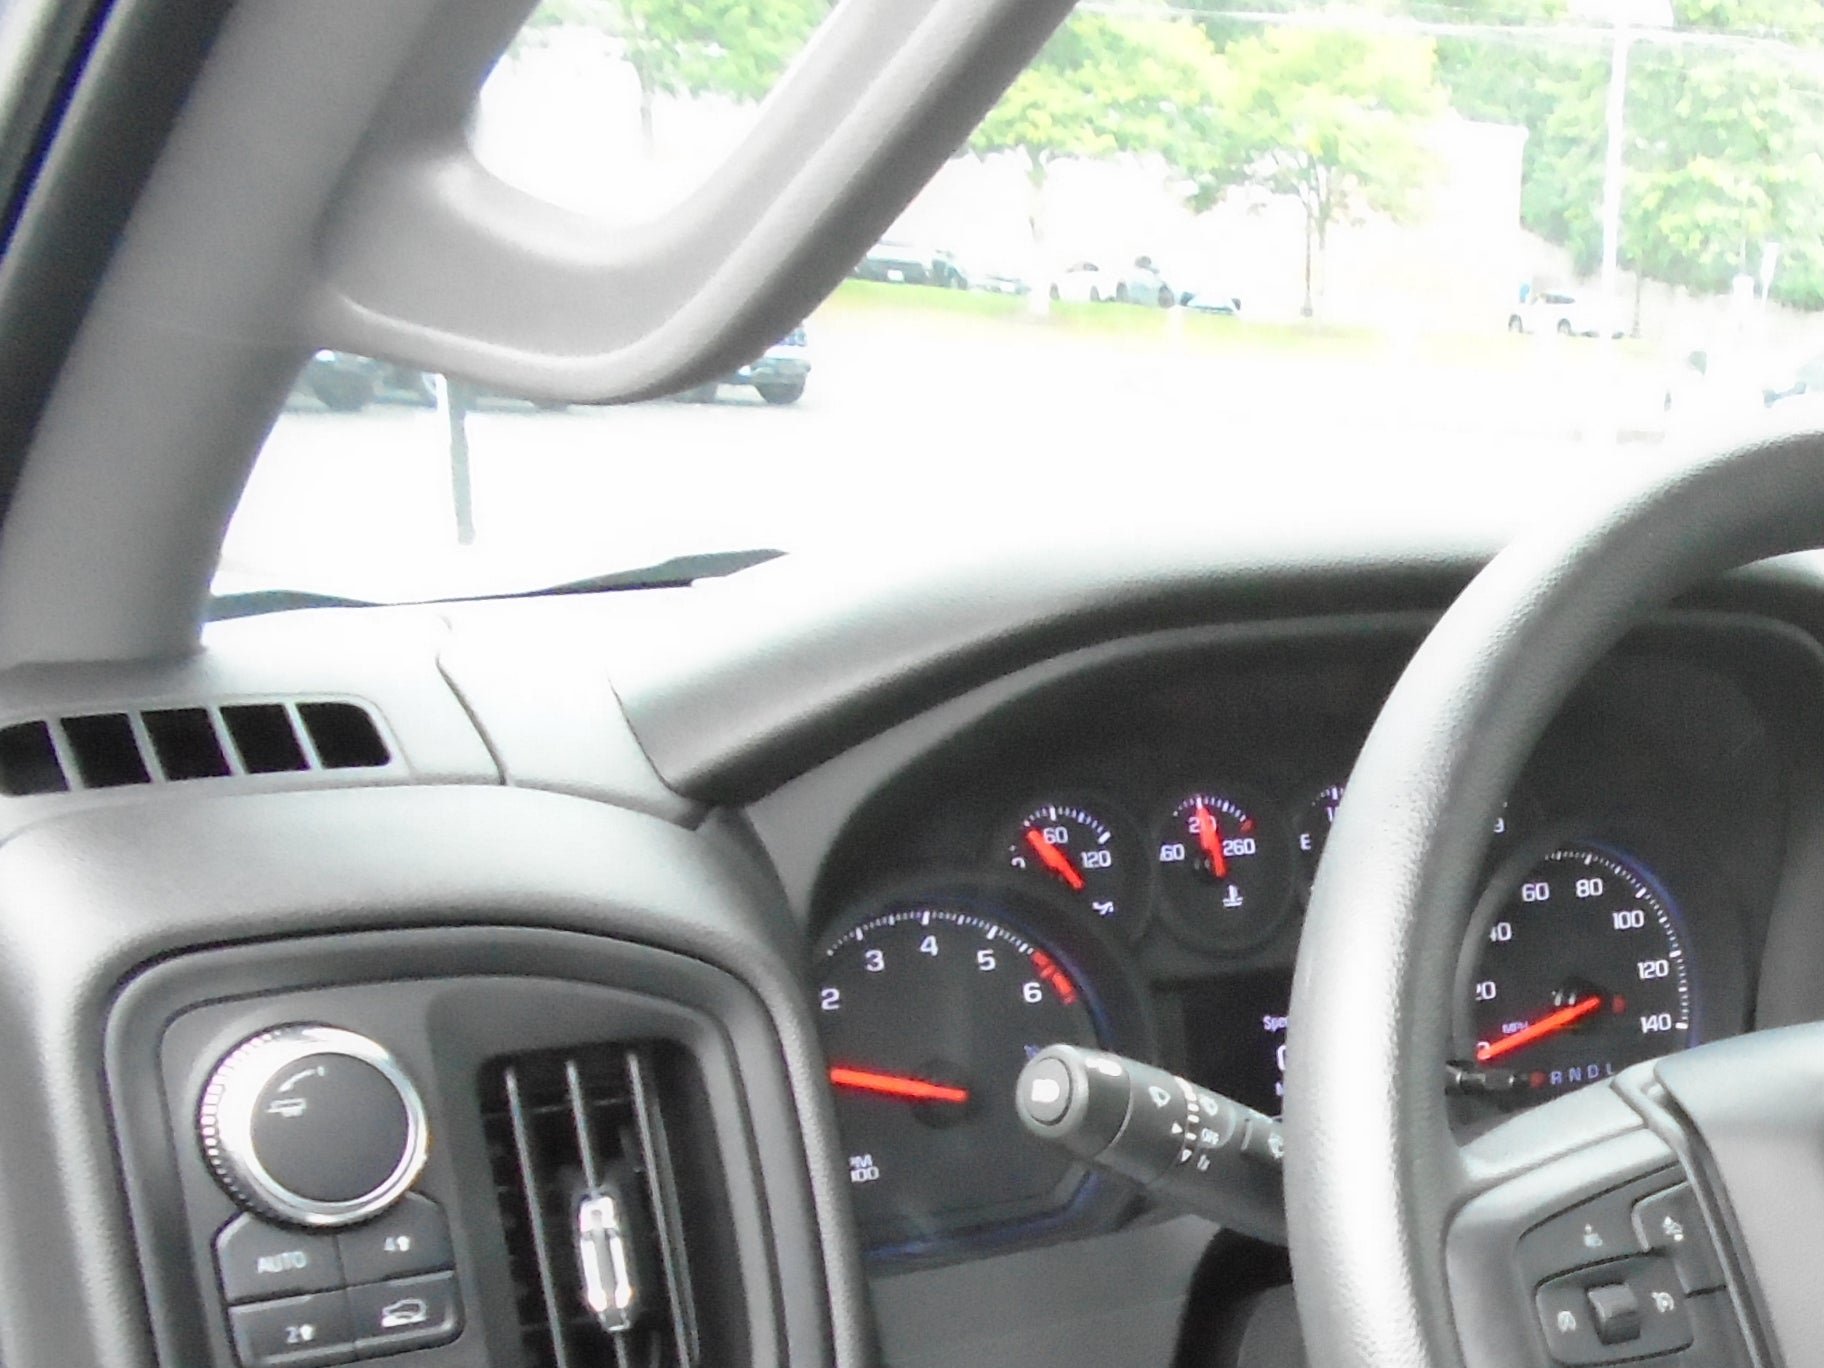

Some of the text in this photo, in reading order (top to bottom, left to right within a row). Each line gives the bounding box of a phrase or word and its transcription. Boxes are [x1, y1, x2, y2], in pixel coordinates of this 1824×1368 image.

[1043, 826, 1069, 844] 60
[1300, 833, 1312, 851] E
[1222, 837, 1256, 857] 260
[1081, 850, 1112, 868] 120
[1521, 881, 1550, 903] 60
[1575, 878, 1603, 898] 80
[1612, 910, 1645, 930] 100
[919, 935, 939, 957] 4
[864, 949, 885, 972] 3
[977, 949, 996, 972] 5
[1637, 959, 1669, 981] 120
[820, 988, 840, 1011] 2
[1022, 981, 1042, 1003] 6
[1640, 1013, 1672, 1034] 140
[1569, 1067, 1581, 1082] N
[1587, 1064, 1599, 1079] D
[256, 1251, 308, 1274] AUTO
